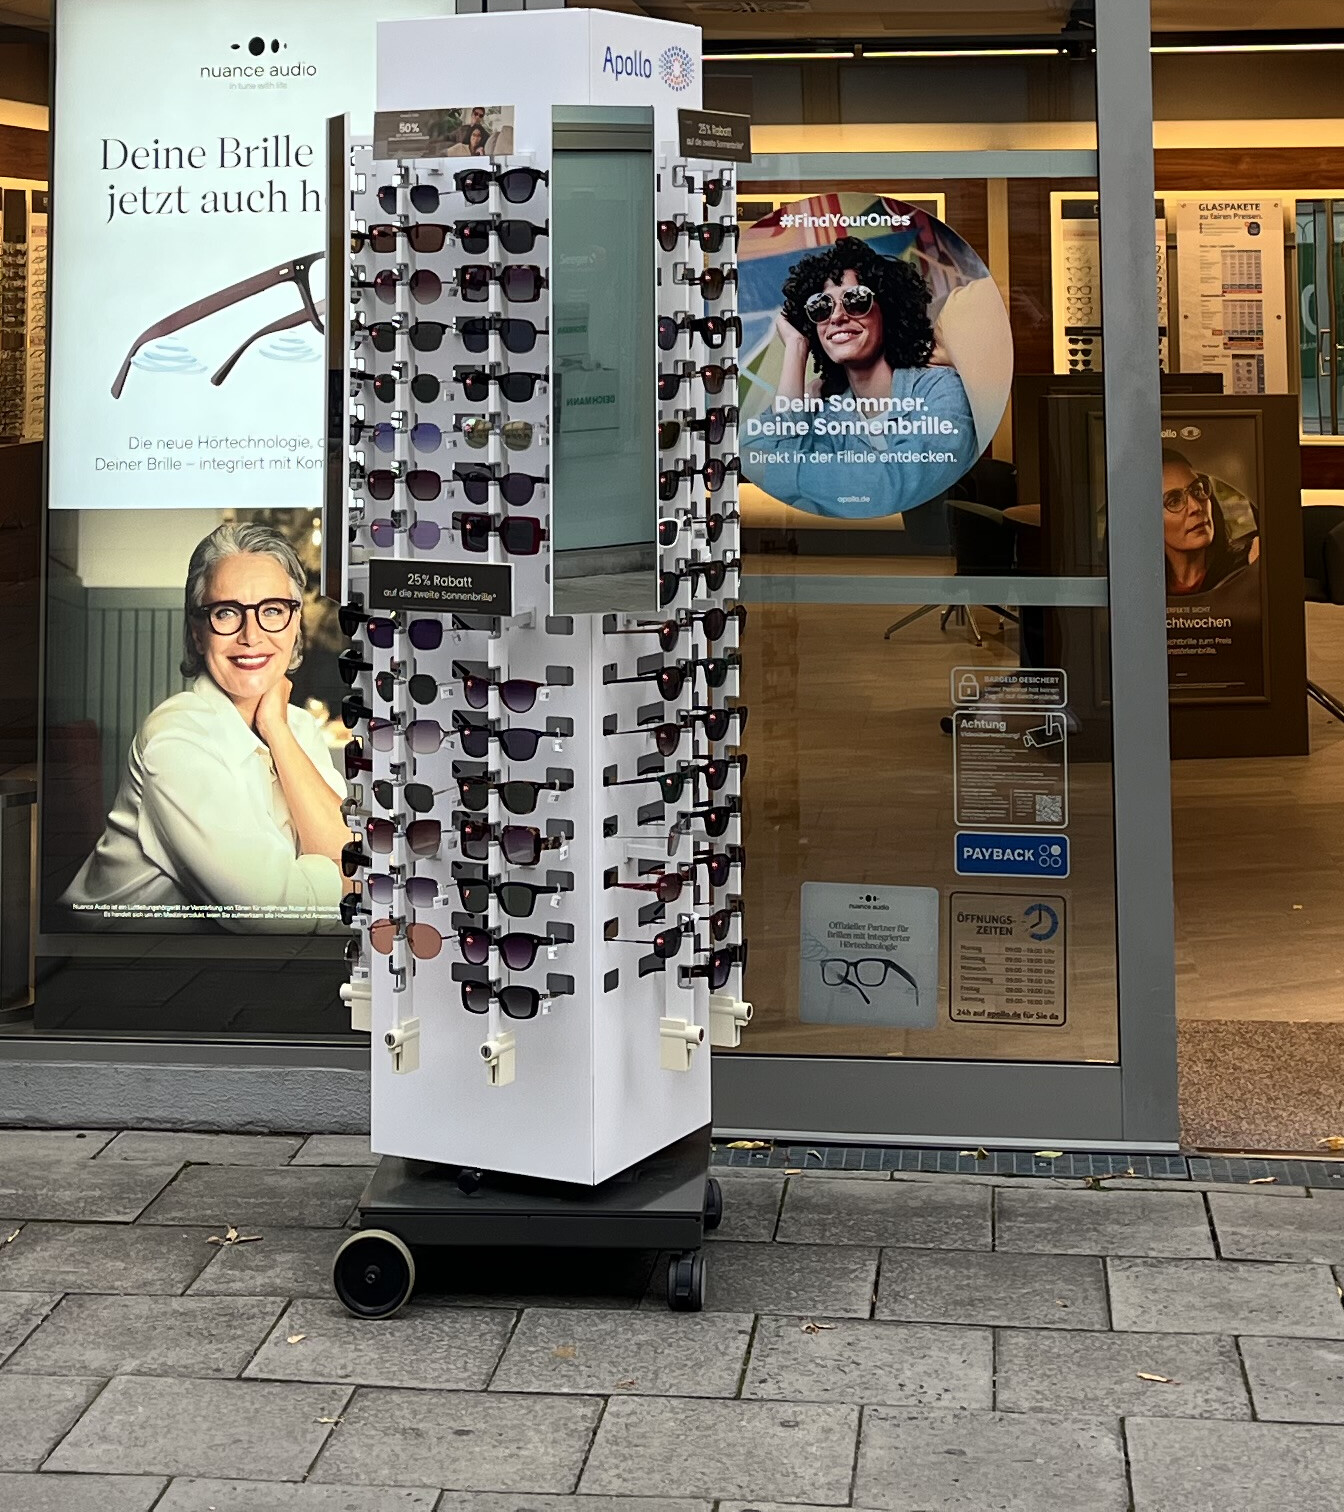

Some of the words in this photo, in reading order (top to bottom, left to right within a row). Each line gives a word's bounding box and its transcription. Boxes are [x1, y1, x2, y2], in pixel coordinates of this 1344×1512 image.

[200, 64, 264, 78] nuance
[269, 61, 317, 77] audio
[603, 46, 652, 81] Apollo
[399, 122, 420, 133] 50%
[100, 138, 206, 170] Deine
[217, 134, 314, 169] Brille
[106, 184, 190, 224] jetzt
[200, 179, 289, 213] auch
[1198, 203, 1261, 211] GLASPAKETE
[779, 213, 911, 228] #FindYourOnes
[775, 395, 824, 413] Dein
[829, 395, 928, 412] Sommer.
[747, 417, 809, 435] Deine
[814, 417, 958, 435] Sonnenbrille.
[128, 436, 152, 450] Die
[156, 439, 193, 450] neue
[198, 436, 313, 452] Hörtechnologie,
[95, 457, 142, 471] Deiner
[147, 457, 182, 471] Brille
[199, 455, 265, 473] integriert
[269, 456, 292, 470] mit
[749, 451, 790, 464] Direkt
[793, 451, 806, 464] in
[810, 451, 833, 464] der
[837, 450, 876, 464] Filiale
[880, 450, 957, 463] entdecken.
[408, 573, 430, 586] 25%
[434, 575, 472, 588] Rabatt
[383, 589, 396, 597] auf
[399, 589, 411, 597] die
[413, 590, 439, 599] zweite
[984, 675, 1017, 683] BARGELD
[1019, 676, 1059, 684] GESICHERT
[960, 719, 1007, 732] Achtung
[963, 847, 1035, 861] PAYBACK
[957, 911, 1017, 925] ÖFFNUNGS-
[829, 921, 866, 930] Offizieller
[867, 923, 896, 931] Partner
[897, 924, 909, 932] für
[976, 926, 1013, 936] ZEITEN
[827, 930, 851, 939] Brillen
[853, 932, 865, 940] mit
[867, 933, 910, 943] integrierter
[839, 940, 898, 952] Hörtechnologie
[987, 1010, 1021, 1019] apollo.de
[1035, 1011, 1048, 1019] Sie
[1049, 1012, 1059, 1020] da
